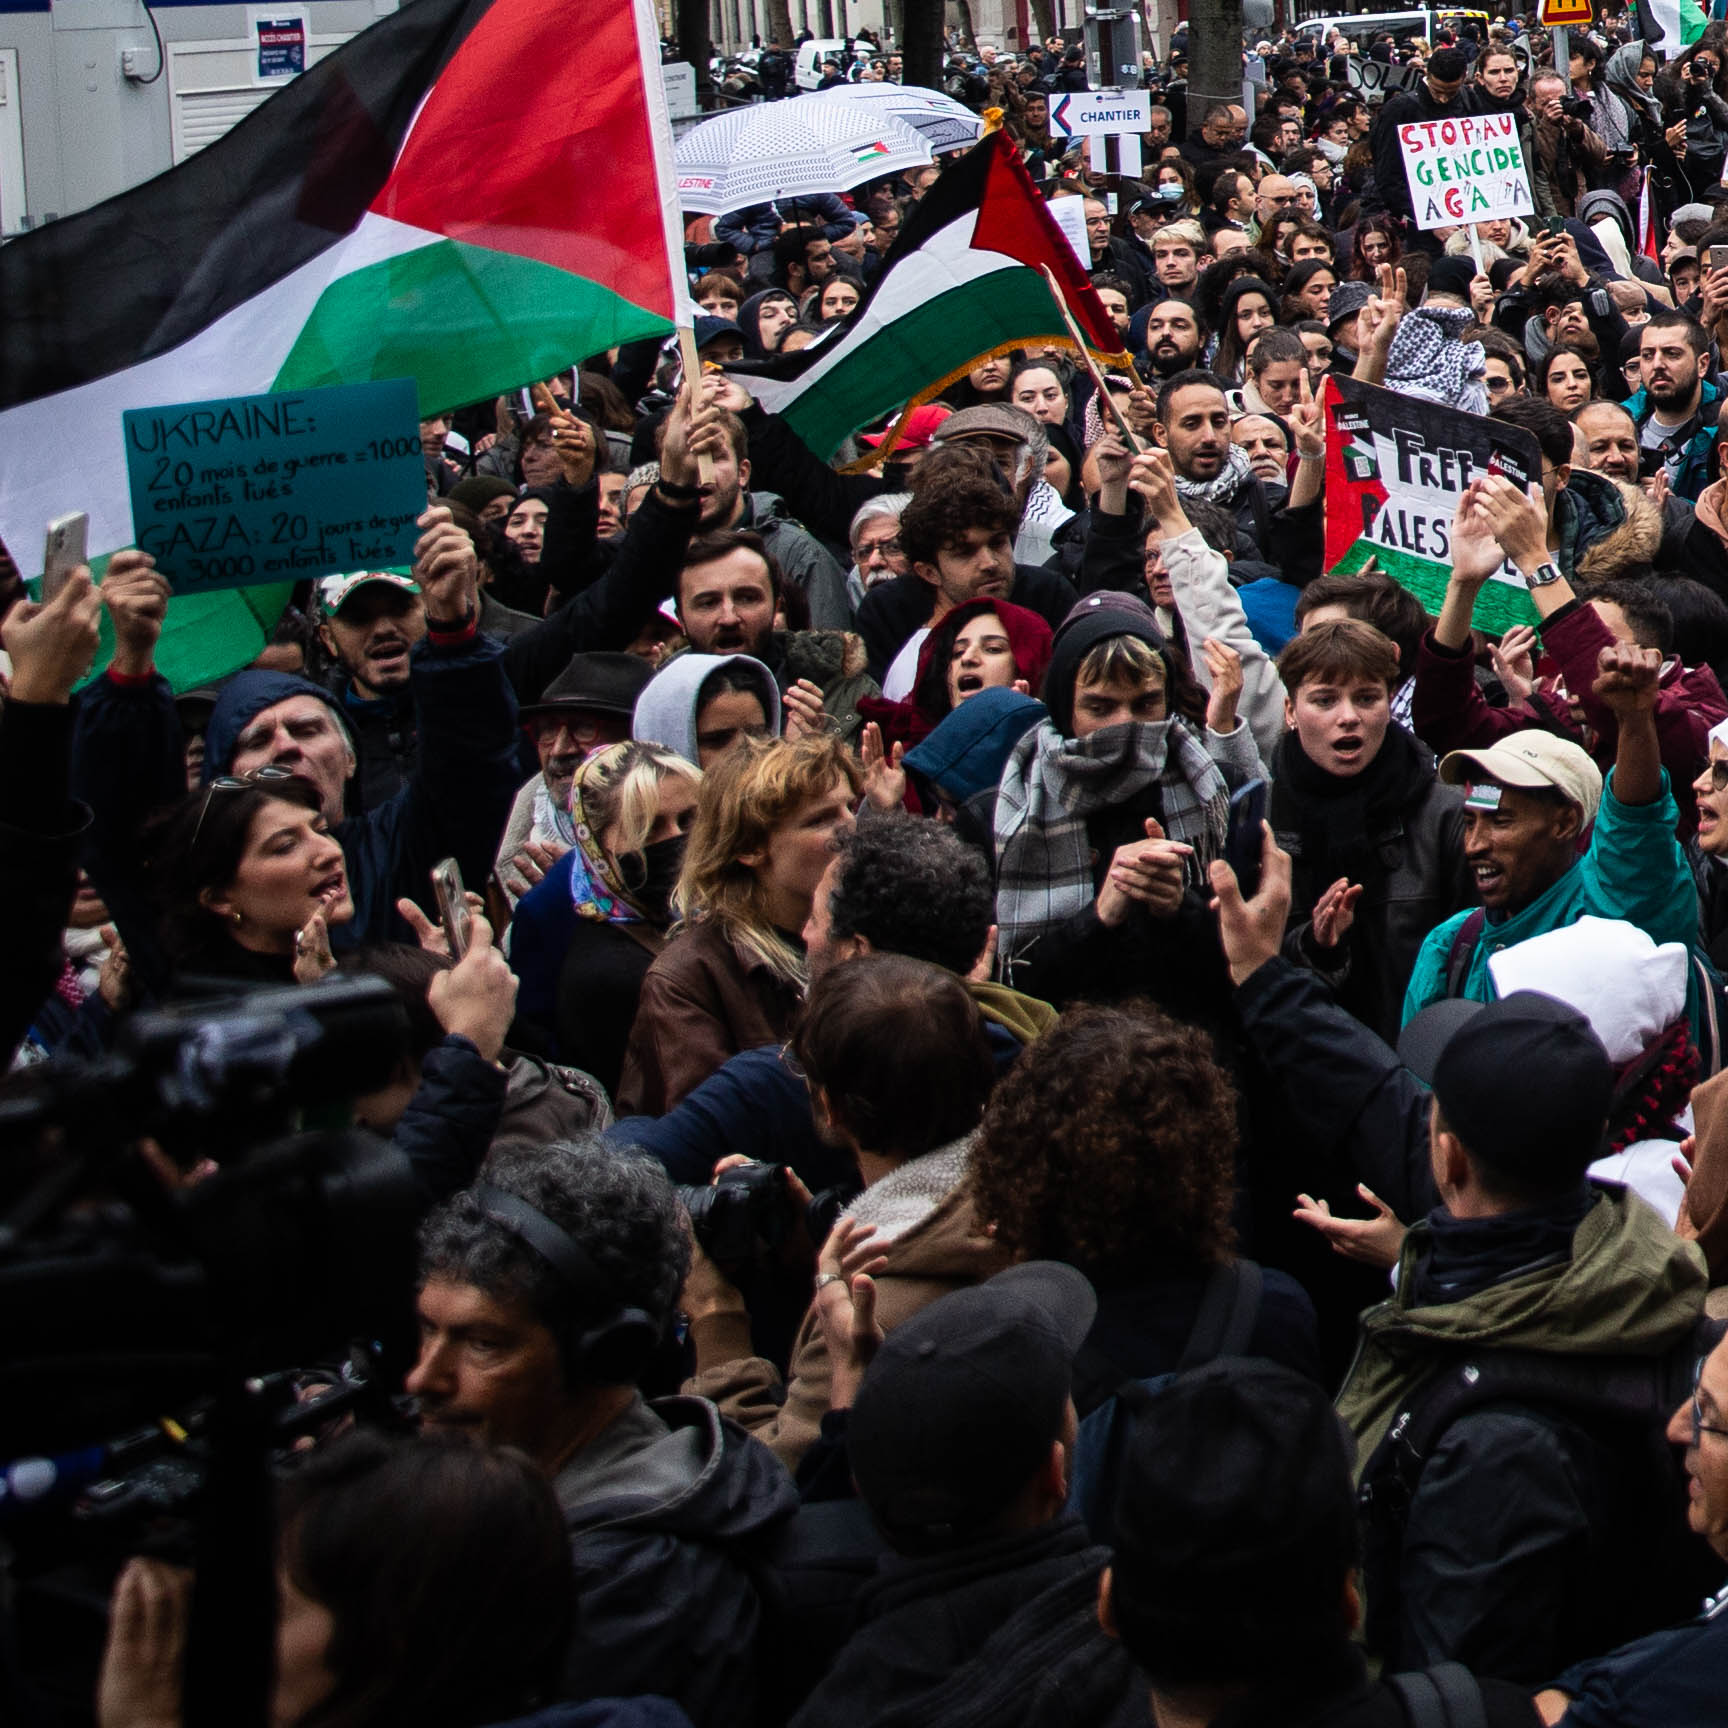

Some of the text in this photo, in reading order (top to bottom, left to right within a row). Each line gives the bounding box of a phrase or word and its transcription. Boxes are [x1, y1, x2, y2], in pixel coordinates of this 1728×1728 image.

[1080, 109, 1141, 123] CHANTIER
[1401, 115, 1512, 154] STOP AU
[679, 177, 713, 189] LESTINE
[1416, 146, 1522, 187] GENCIDE
[148, 456, 195, 492] 20
[201, 461, 248, 482] mois
[253, 458, 280, 476] de
[283, 452, 348, 480] guerre
[1392, 427, 1474, 493] FREE
[153, 479, 294, 512] enfants tués
[271, 511, 309, 545] 20
[318, 518, 364, 553] jours
[186, 537, 397, 582] 3000 enfants tués
